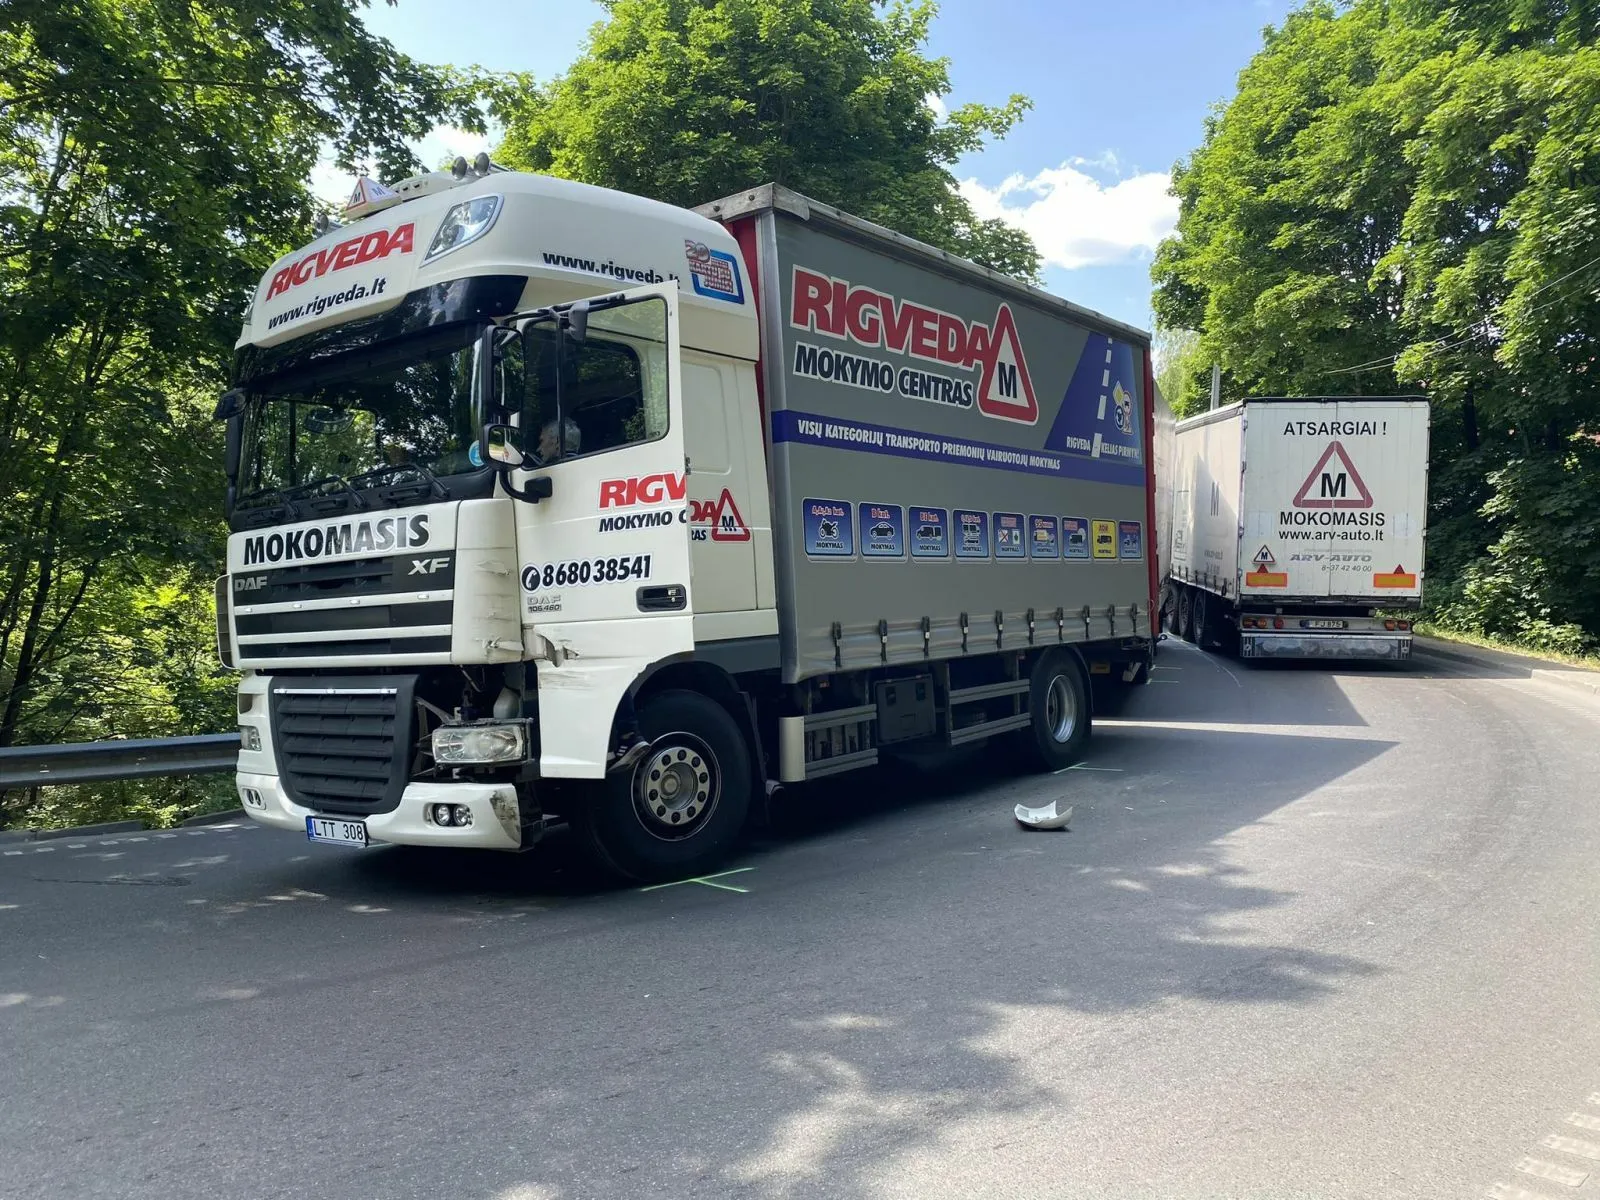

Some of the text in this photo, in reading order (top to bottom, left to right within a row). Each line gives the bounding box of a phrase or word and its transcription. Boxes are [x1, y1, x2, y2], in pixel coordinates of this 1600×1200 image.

[266, 223, 415, 301] RIGVEDA
[542, 252, 680, 290] www.rigveda
[268, 277, 387, 330] www.rigveda.lt
[791, 267, 990, 369] RIGVEDA
[795, 344, 972, 407] MOKYMO CENTRAS
[998, 361, 1018, 399] M
[1283, 421, 1387, 436] ATSARGIAI !
[798, 419, 1060, 470] VISŲ KATEGORIJŲ TRANSPORTO PRIEMONIŲ VAIRUOTOJŲ MOKYMAS
[1066, 436, 1091, 451] RIGVEDA
[1321, 473, 1346, 498] M
[599, 511, 673, 533] MOKYMO
[1279, 511, 1385, 526] MOKOMASIS
[243, 514, 430, 566] MOKOMASIS
[815, 541, 843, 549] MOKYMAS
[1278, 529, 1384, 541] www.arv-auto.lt
[870, 543, 895, 551] MOKYMAS
[1260, 551, 1268, 560] M
[407, 557, 450, 576] XF
[1290, 554, 1372, 562] ARV-AUTO
[234, 576, 268, 592] DAF
[527, 595, 561, 605] DAF
[313, 820, 364, 841] LTT 308
